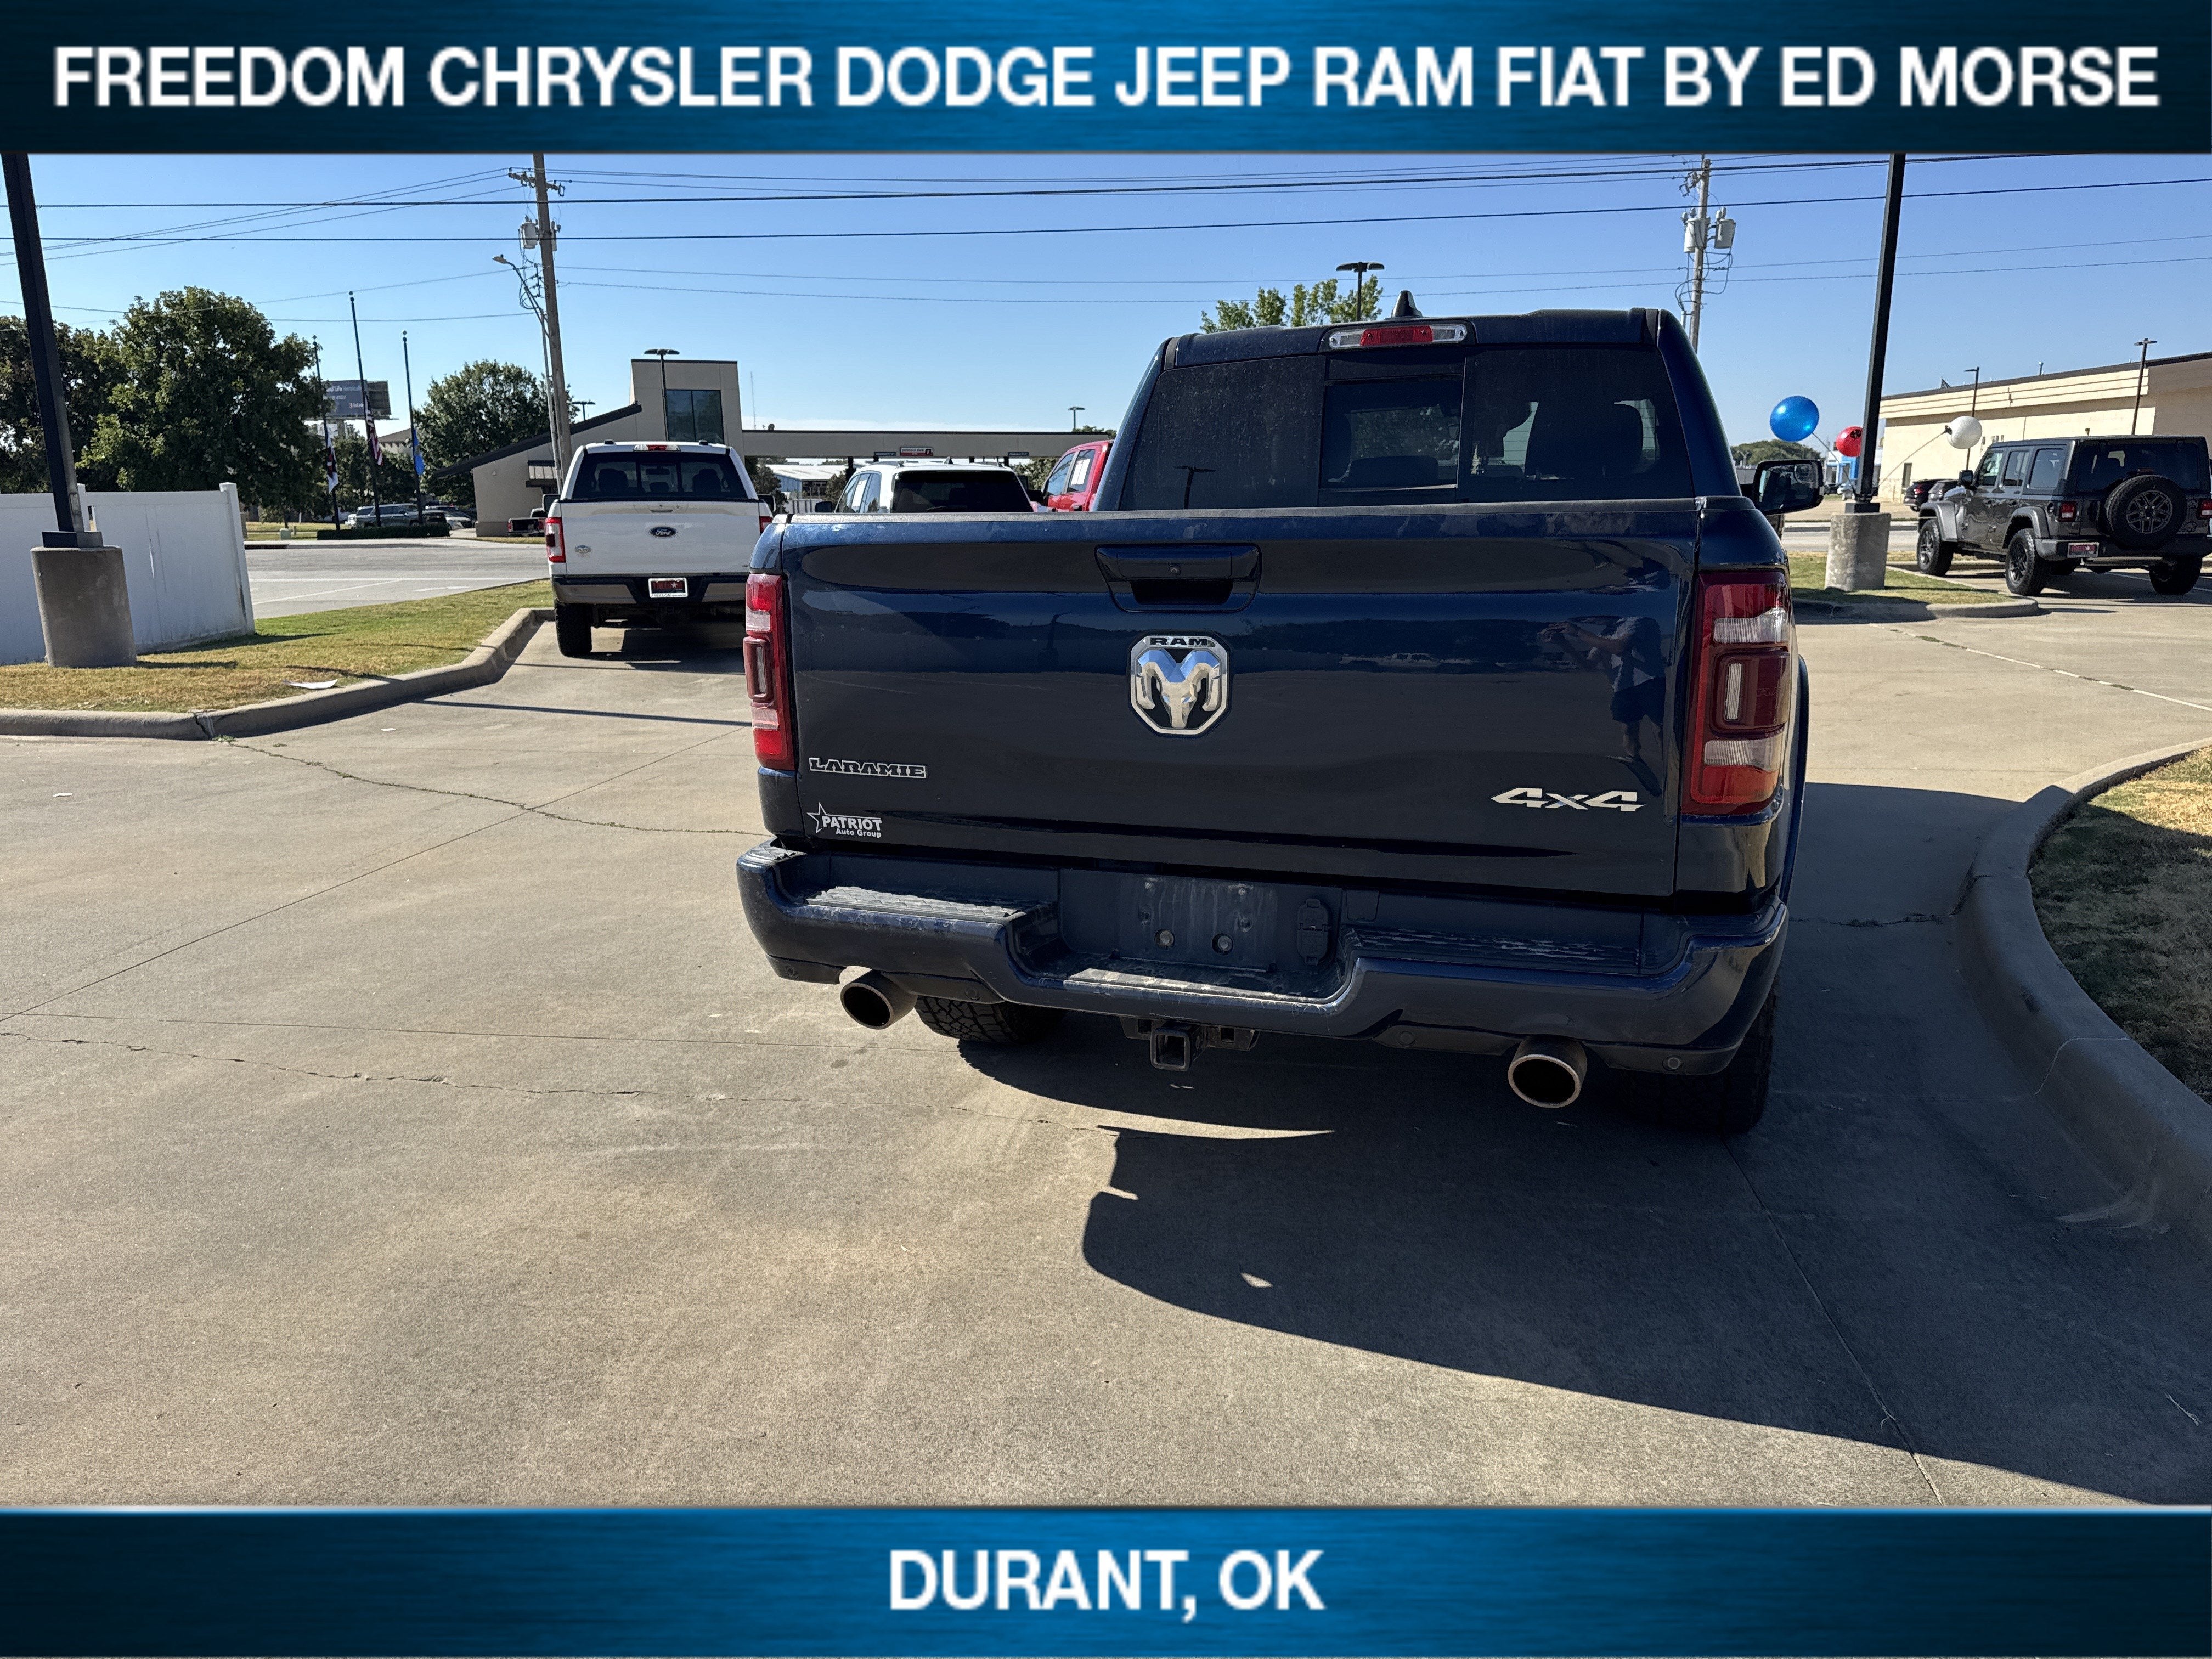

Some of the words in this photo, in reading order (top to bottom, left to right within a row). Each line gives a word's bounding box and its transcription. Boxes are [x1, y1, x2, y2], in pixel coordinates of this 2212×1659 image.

[1150, 637, 1208, 646] RAM
[809, 757, 927, 779] LARAMIE
[1490, 787, 1647, 812] 4x4
[822, 815, 882, 831] PATRIOT
[836, 827, 855, 836] Auto
[856, 829, 882, 839] Group
